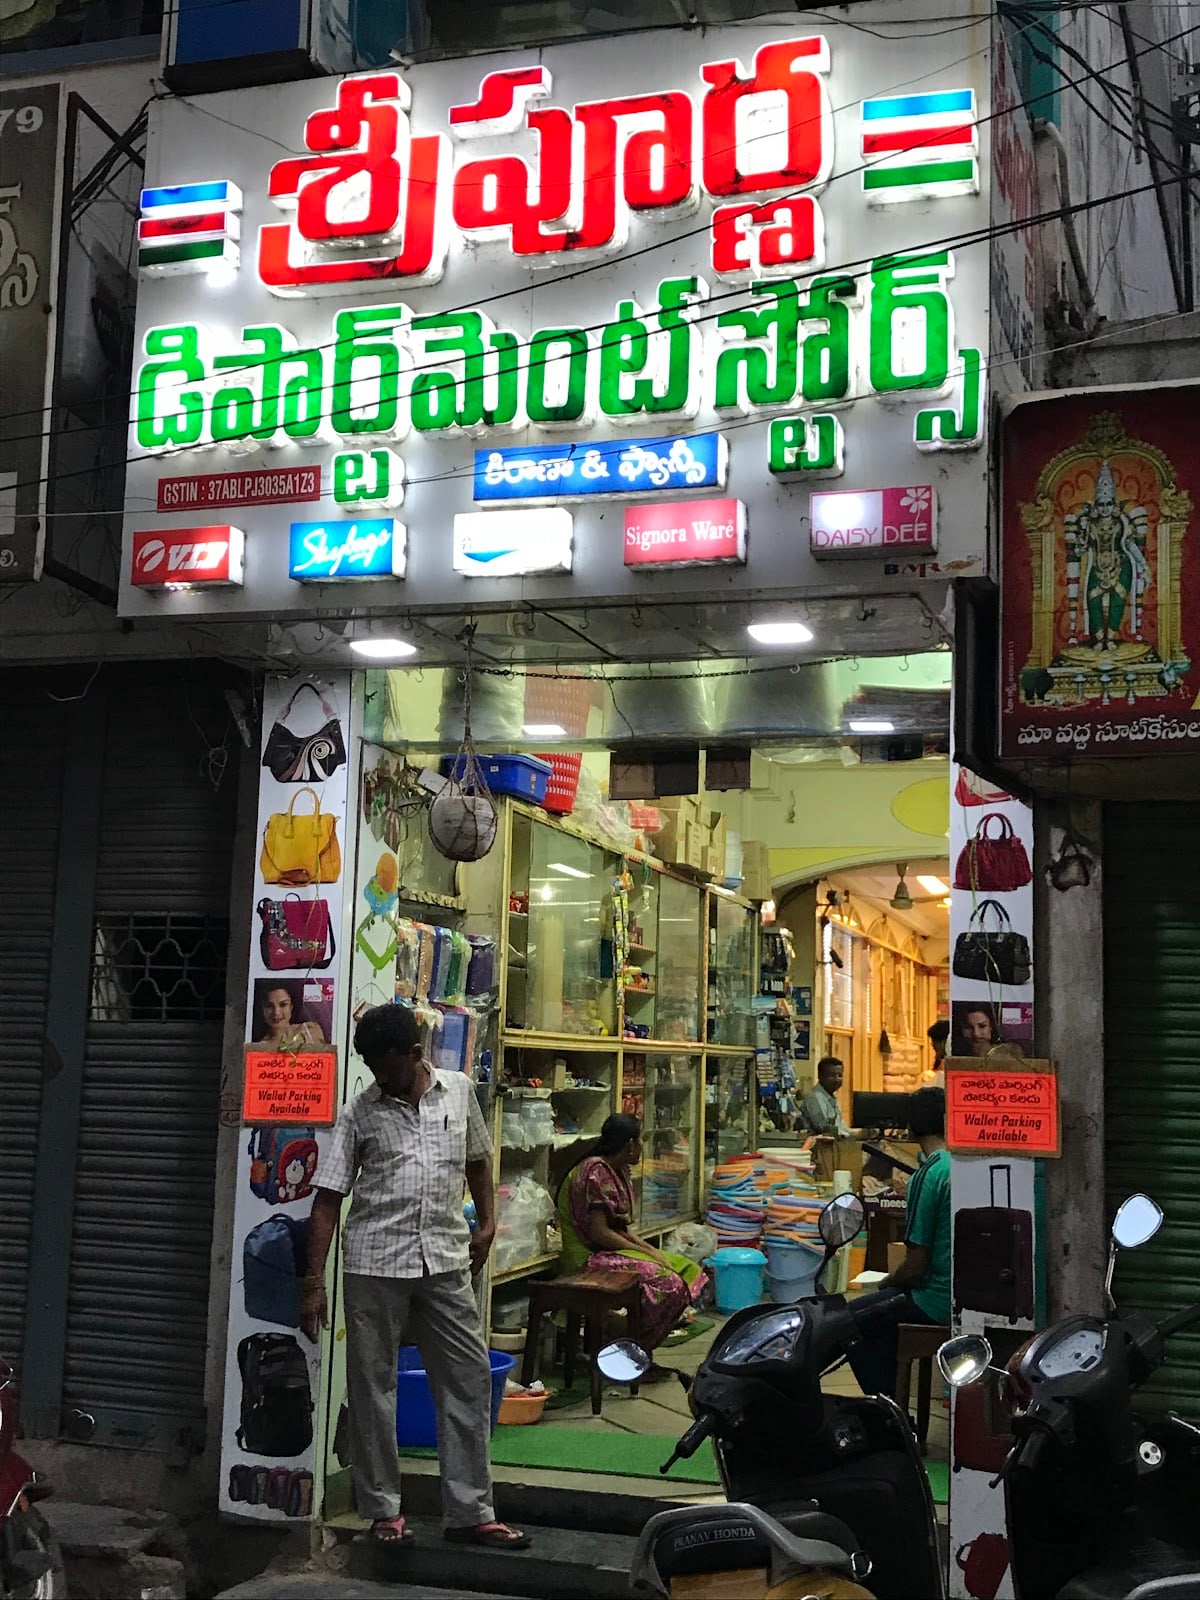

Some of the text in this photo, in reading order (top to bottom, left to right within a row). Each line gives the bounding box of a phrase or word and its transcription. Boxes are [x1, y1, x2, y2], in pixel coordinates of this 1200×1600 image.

[581, 449, 610, 478] &
[163, 482, 198, 504] GSTIN
[207, 472, 315, 500] 37ABLPJ3035A1Z3
[626, 526, 687, 551] Signora
[815, 523, 928, 547] DAISY DEE
[1017, 724, 1052, 745] మా
[1055, 723, 1091, 750] వద్ద
[258, 1090, 322, 1104] Wallet Parking
[269, 1103, 310, 1114] Available
[964, 1113, 1042, 1131] Wallet Parking
[977, 1128, 1028, 1142] Available
[714, 1527, 756, 1540] HONDA
